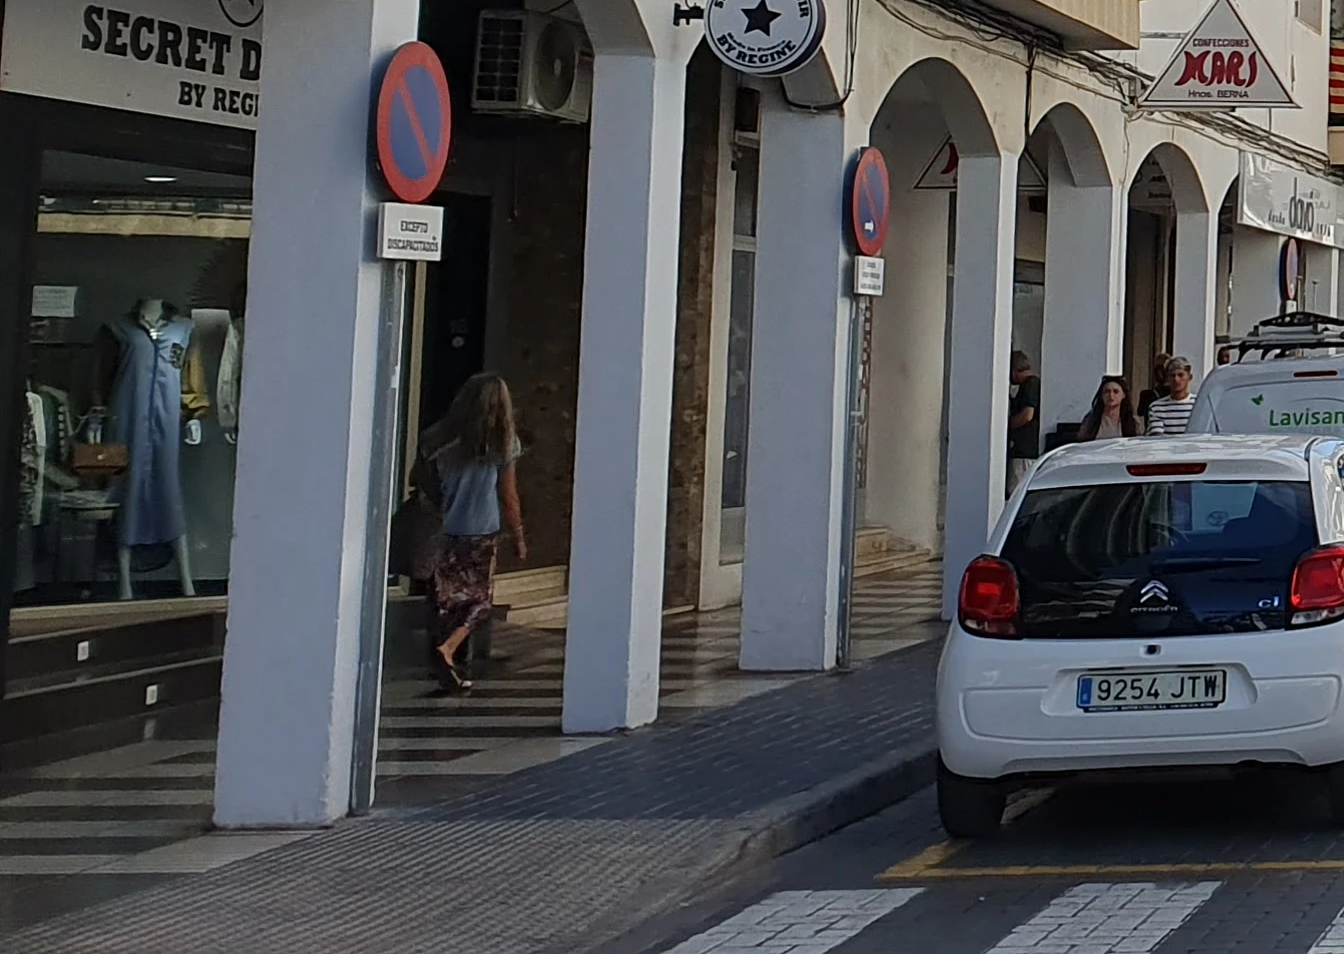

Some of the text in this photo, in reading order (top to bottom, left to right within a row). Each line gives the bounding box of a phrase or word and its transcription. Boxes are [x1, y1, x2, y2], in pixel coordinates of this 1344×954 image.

[81, 4, 262, 81] SECRET D
[717, 34, 796, 64] BY REGINE
[1192, 38, 1250, 48] CONFECCIONES
[178, 80, 260, 118] BY REGI
[1217, 90, 1250, 99] BERNA
[400, 220, 428, 233] EXCEPTO
[387, 237, 439, 252] DISCAPACITADOS
[1097, 675, 1218, 701] 9254 JTW
